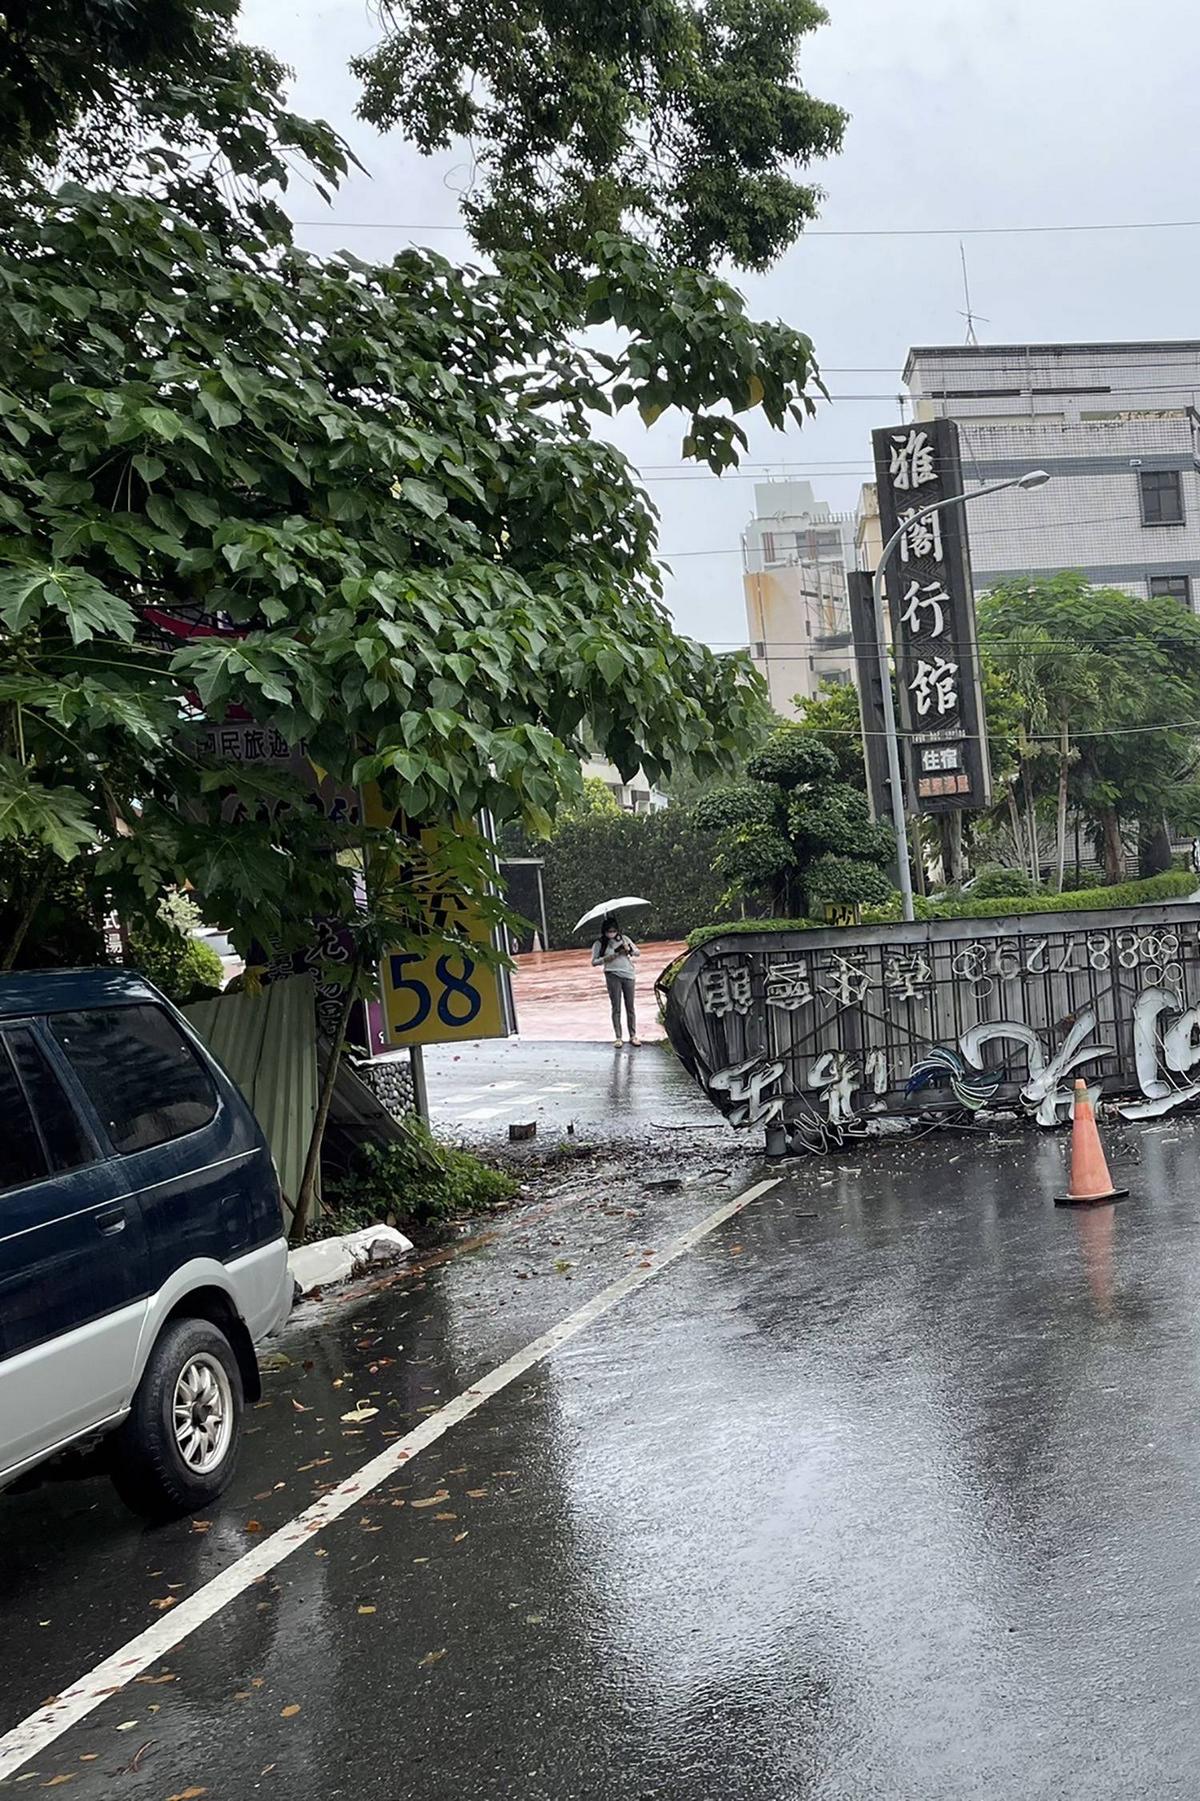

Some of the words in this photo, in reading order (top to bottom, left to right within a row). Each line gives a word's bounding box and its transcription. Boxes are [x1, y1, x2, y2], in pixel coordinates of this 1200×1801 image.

[889, 430, 960, 716] 雅閣行館
[922, 748, 958, 771] 住宿
[390, 953, 482, 1033] 58
